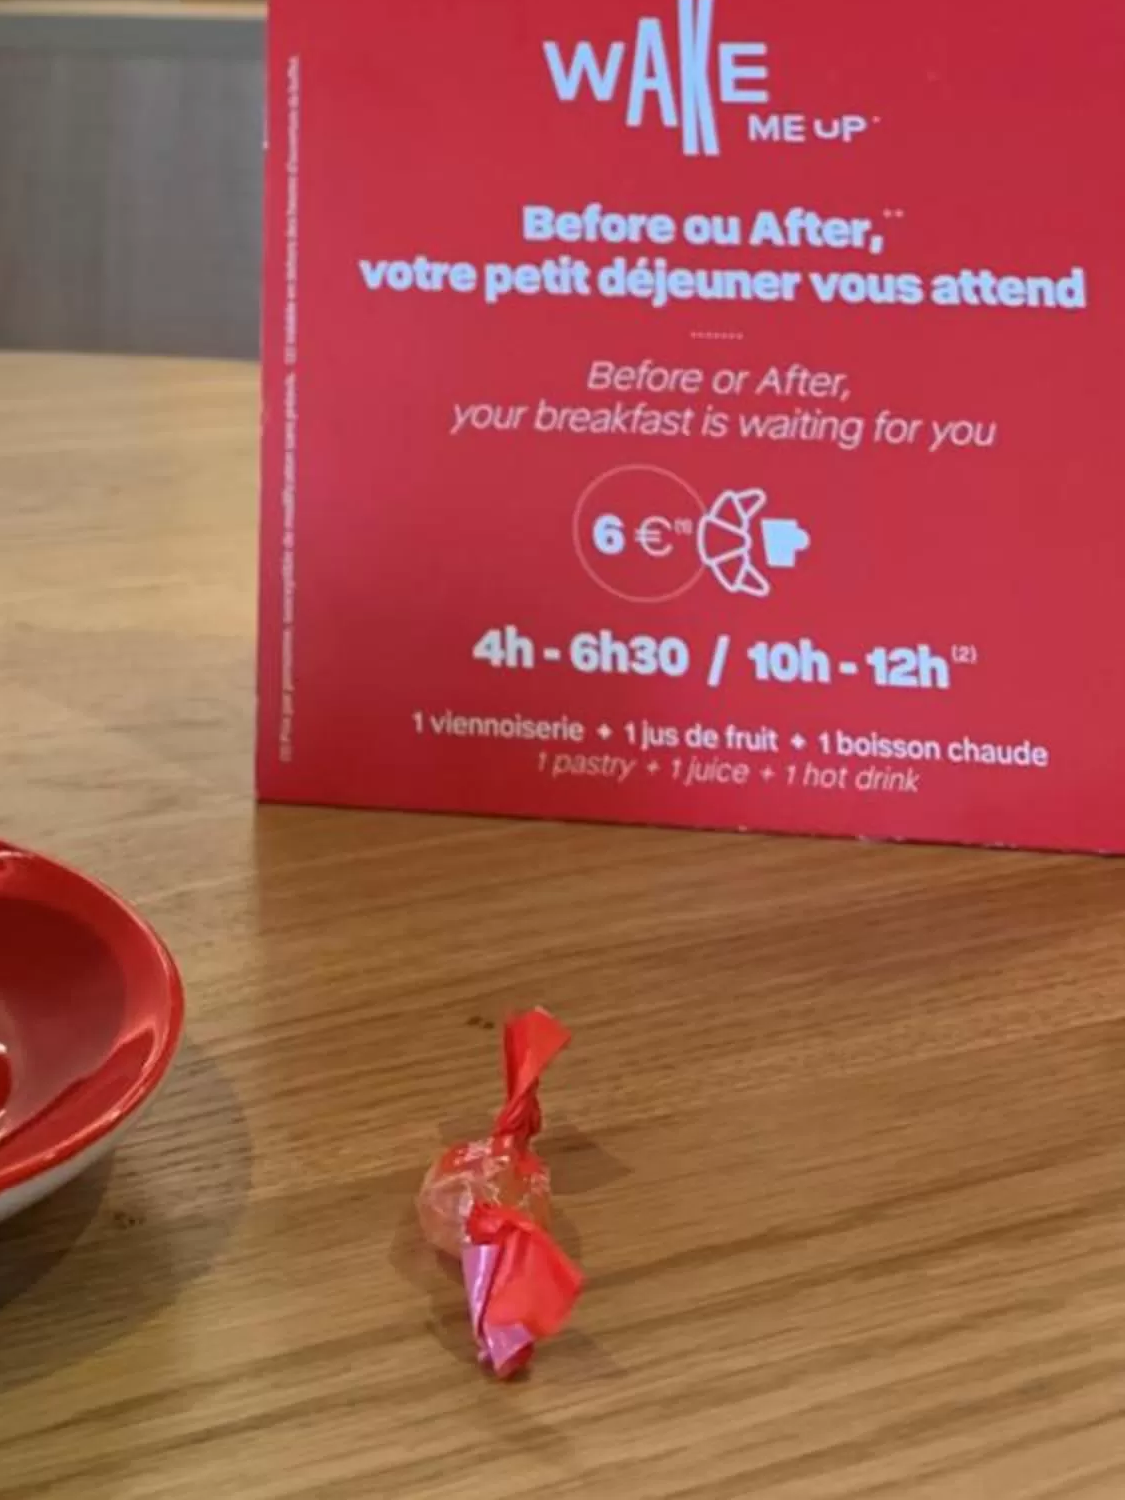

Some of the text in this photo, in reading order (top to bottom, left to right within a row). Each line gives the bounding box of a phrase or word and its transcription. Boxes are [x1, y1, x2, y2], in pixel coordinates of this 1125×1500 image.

[747, 113, 807, 143] ME
[522, 202, 884, 255] Before ou After,
[357, 254, 1088, 309] votre petit déjeuner vous attend
[586, 359, 852, 401] Before or After,
[450, 398, 997, 453] your breakfast is waiting for you
[592, 512, 626, 556] 6
[471, 623, 535, 670] 4h
[569, 629, 691, 678] 6h30
[746, 636, 832, 684] 10h
[412, 711, 423, 734] 1
[430, 710, 585, 742] viennoiserie
[624, 721, 636, 745] 1
[640, 719, 680, 751] jus
[684, 723, 719, 749] de
[726, 724, 779, 753] fruit
[819, 731, 830, 755] 1
[835, 729, 941, 761] boisson
[947, 736, 1049, 767] chaude
[551, 751, 637, 782] pastry
[684, 756, 751, 786] juice
[801, 761, 849, 789] hot
[854, 764, 920, 793] drink
